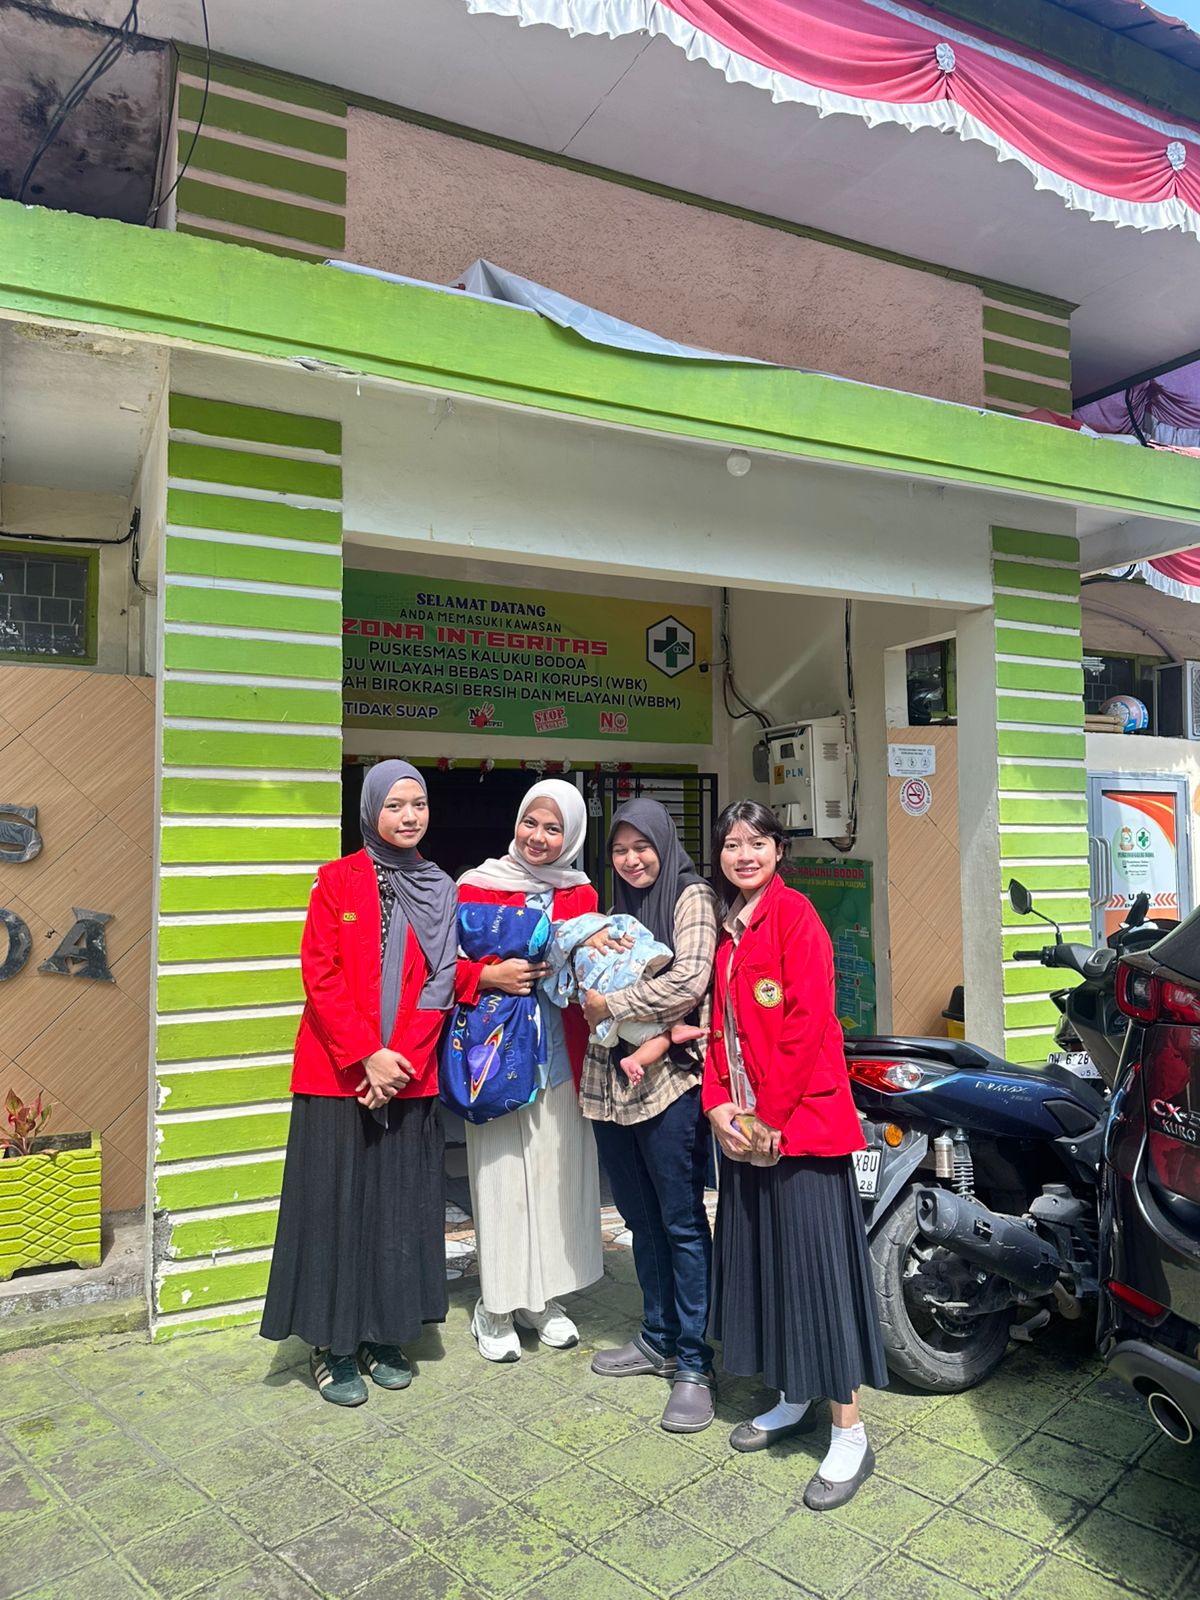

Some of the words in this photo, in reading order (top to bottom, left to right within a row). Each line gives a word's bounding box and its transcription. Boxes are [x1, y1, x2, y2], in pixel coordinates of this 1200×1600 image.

[416, 592, 488, 611] SELAMAT
[490, 600, 546, 617] DATANG
[399, 608, 434, 621] ANDA
[437, 612, 503, 627] MEMASUKI
[505, 618, 562, 633] KAWASAN
[343, 618, 424, 640] ZONA
[437, 626, 608, 656] INTEGRITAS
[369, 641, 467, 660] PUSKESMAS
[471, 650, 531, 666] KALUKU
[534, 655, 586, 670] BODOA
[369, 659, 444, 676] WILAYAH
[448, 665, 499, 681] BEBAS
[503, 670, 538, 683] DARI
[542, 672, 602, 688] KORUPSI
[606, 676, 648, 692] (WBK)
[372, 677, 458, 696] BIROKRASI
[462, 684, 517, 699] BERSIH
[521, 688, 551, 701] DAN
[555, 690, 625, 706] MELAYANI
[628, 695, 681, 710] (WBBM)
[344, 702, 392, 716] TIDAK
[396, 704, 439, 719] SUAP
[534, 707, 565, 723] STOP
[785, 767, 804, 778] PLN
[505, 1032, 518, 1080] SATURN
[1065, 1053, 1089, 1065] 628
[1162, 1119, 1197, 1142] KURO
[859, 1179, 873, 1191] 28
